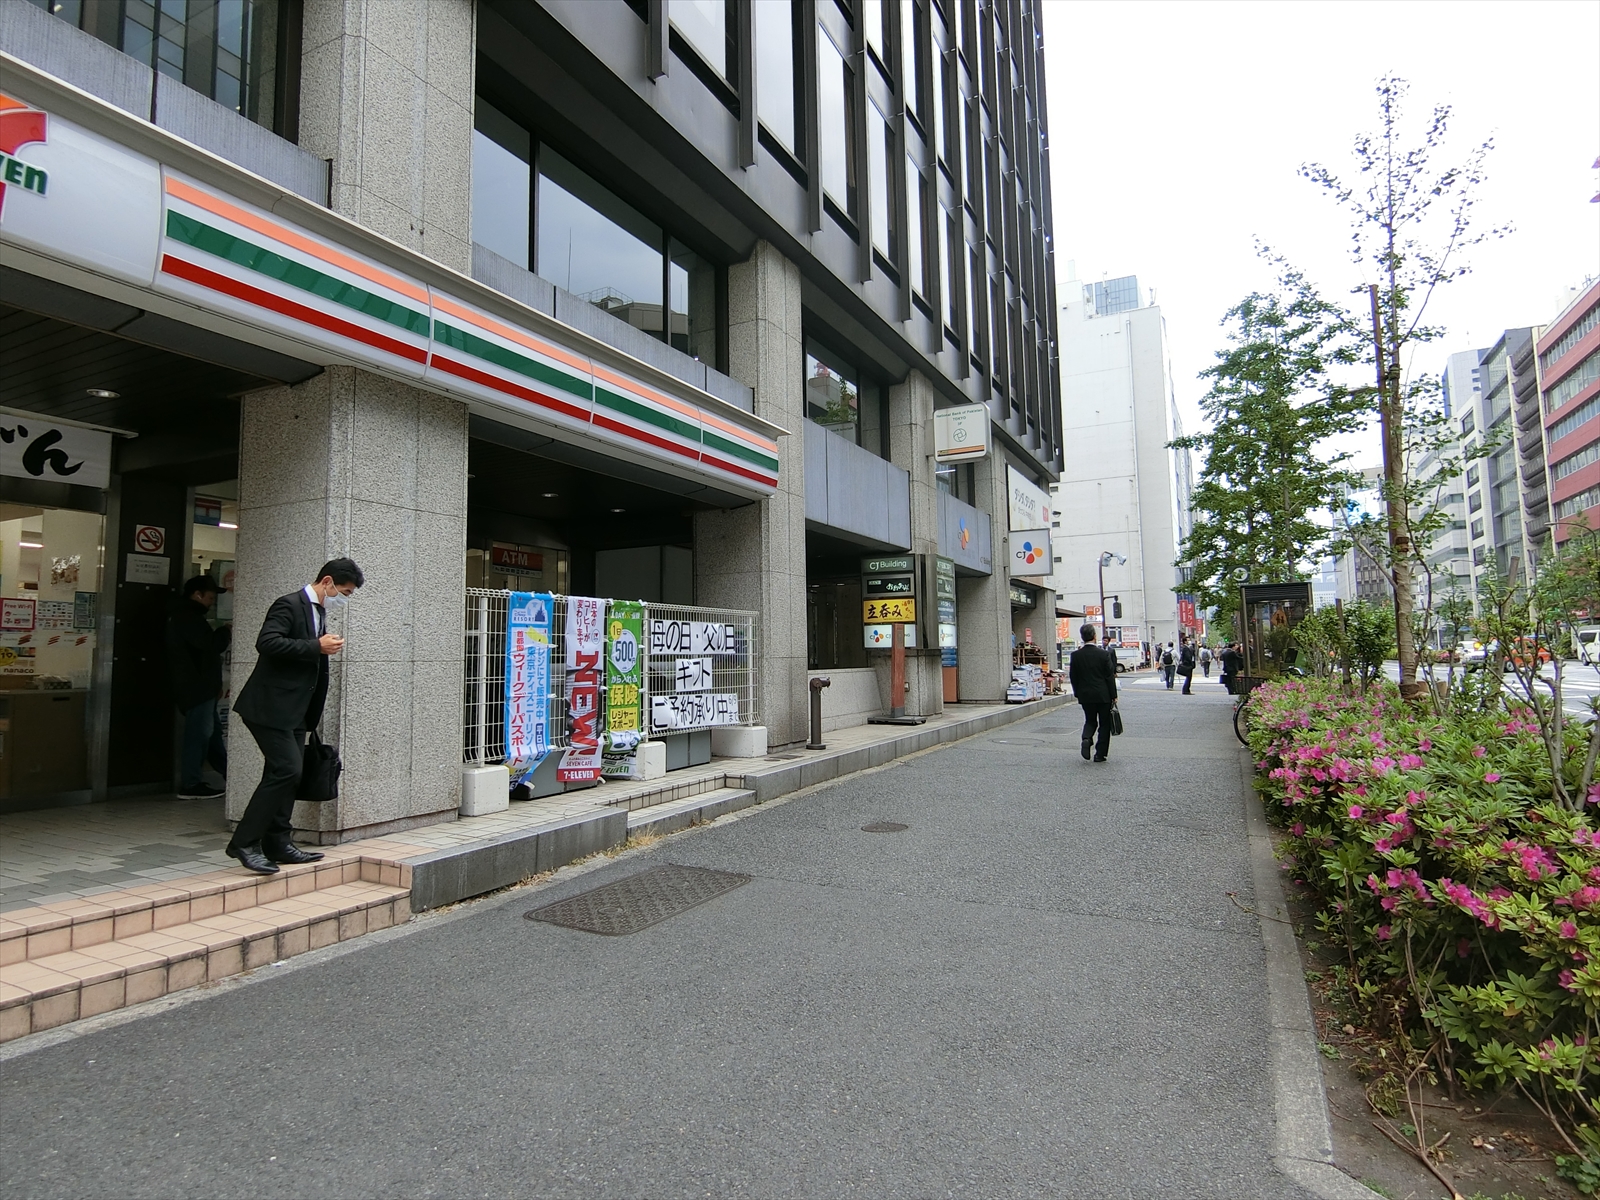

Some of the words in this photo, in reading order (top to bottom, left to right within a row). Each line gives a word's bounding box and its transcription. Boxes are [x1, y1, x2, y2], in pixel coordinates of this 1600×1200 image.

[501, 550, 529, 566] ATM
[869, 562, 879, 571] CJ
[880, 560, 907, 569] Building
[1015, 551, 1026, 560] CJ
[867, 602, 903, 620] 立呑み
[583, 600, 591, 643] コーヒーが
[651, 620, 735, 652] 母の日・父の日
[676, 659, 711, 689] ギフト
[610, 684, 638, 706] 保険
[653, 694, 728, 728] ご予約承り中
[611, 719, 634, 730] スポーツ
